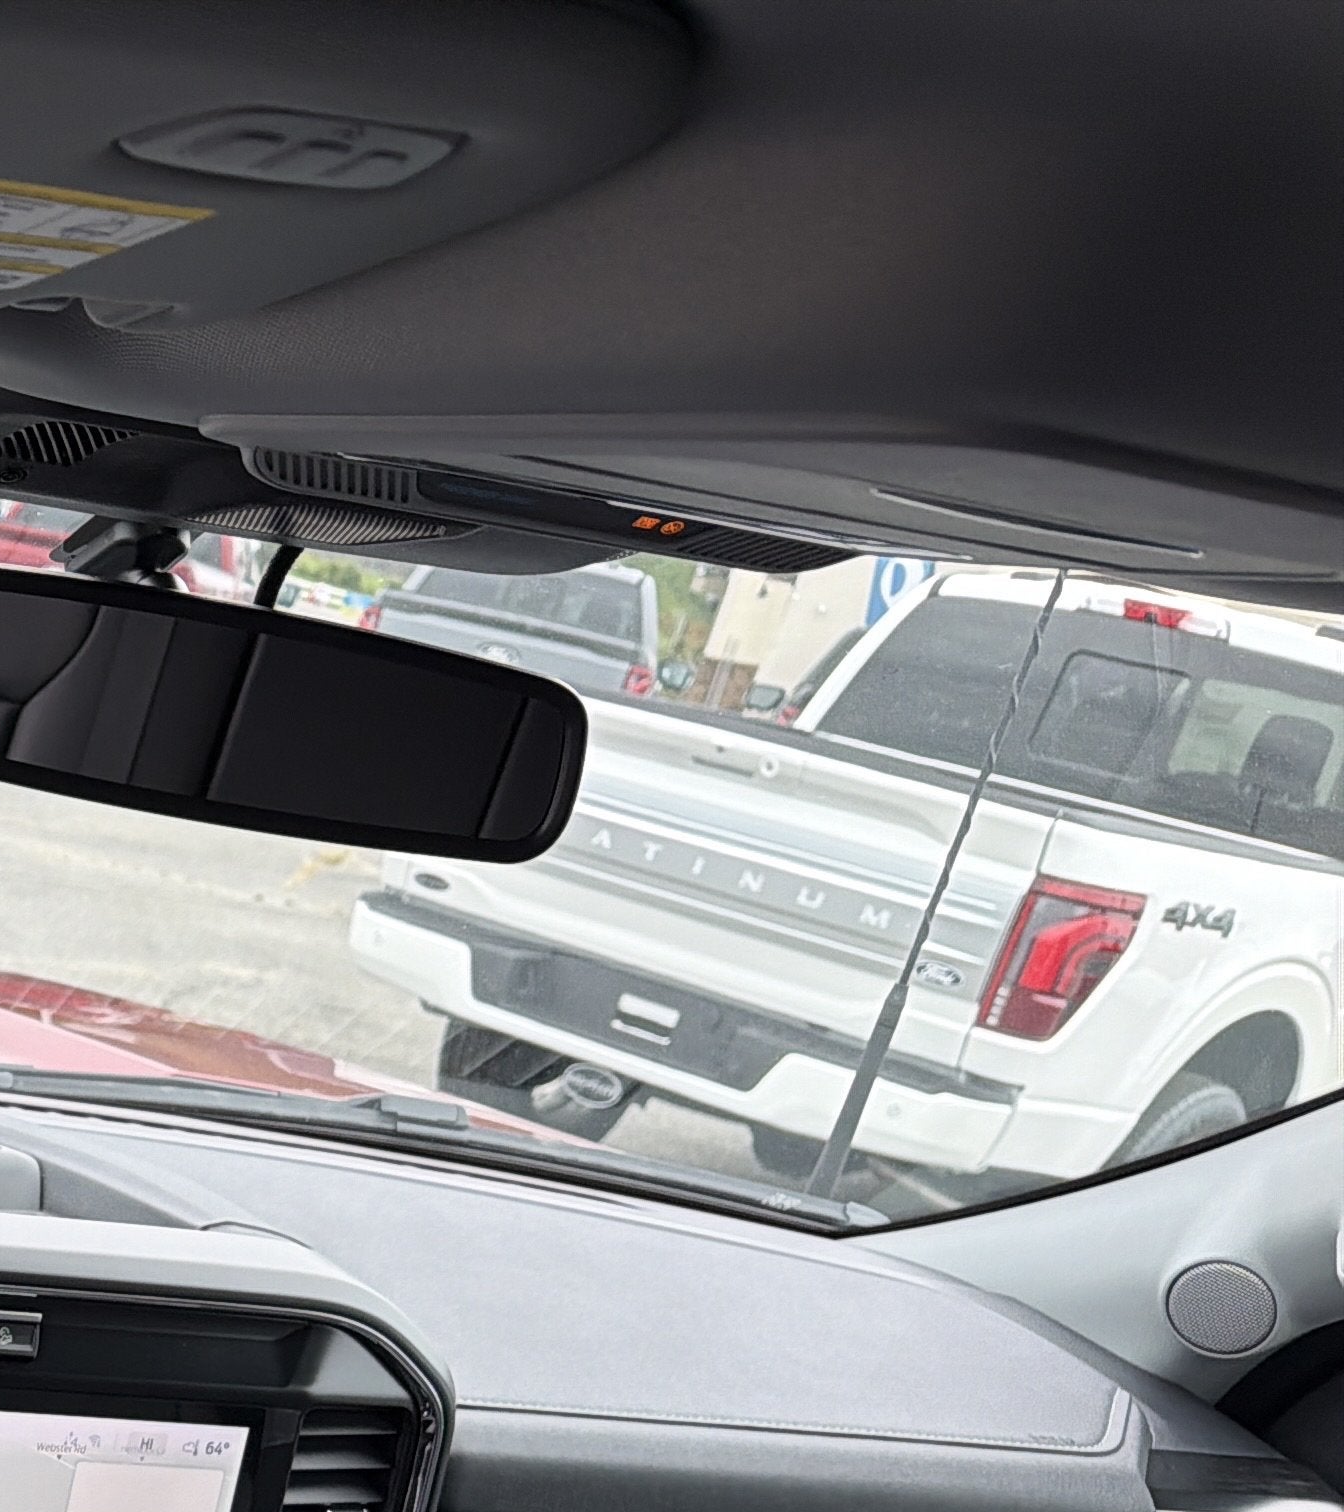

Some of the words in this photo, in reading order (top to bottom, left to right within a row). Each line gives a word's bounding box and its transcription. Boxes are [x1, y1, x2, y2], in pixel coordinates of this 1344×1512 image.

[590, 827, 893, 930] ATINUM
[1162, 900, 1237, 938] 4X4
[37, 1441, 72, 1453] Webster
[140, 1437, 154, 1450] HI
